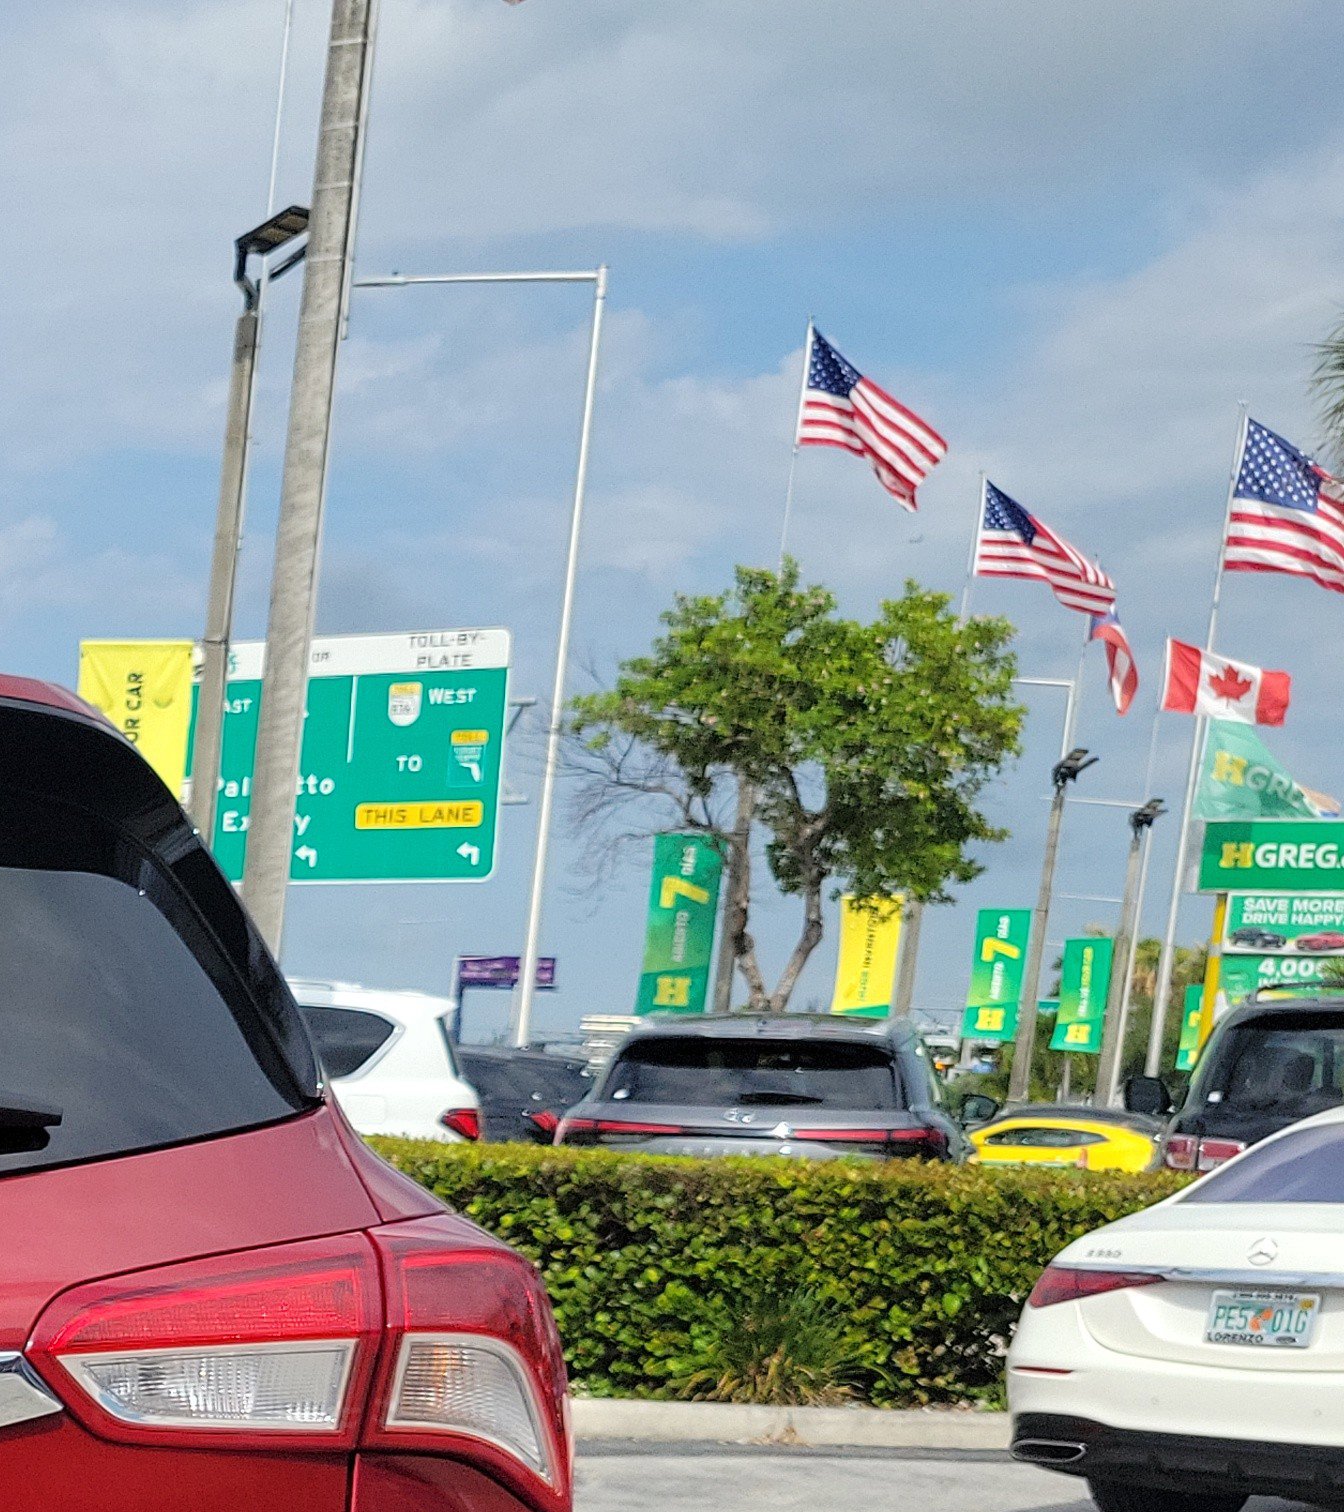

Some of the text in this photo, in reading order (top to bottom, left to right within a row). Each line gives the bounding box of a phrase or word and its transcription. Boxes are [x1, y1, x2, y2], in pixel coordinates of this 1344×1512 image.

[416, 653, 474, 669] PLATE
[126, 672, 144, 711] CAR
[427, 687, 478, 706] WEST
[223, 697, 253, 715] AST
[395, 753, 423, 772] TO
[361, 806, 475, 825] THIS LANE
[659, 876, 710, 909] 7
[1243, 898, 1344, 912] SAVE MORE
[1242, 912, 1289, 924] DRIVE
[980, 936, 1021, 962] 7
[1207, 1331, 1264, 1344] LORENZO
